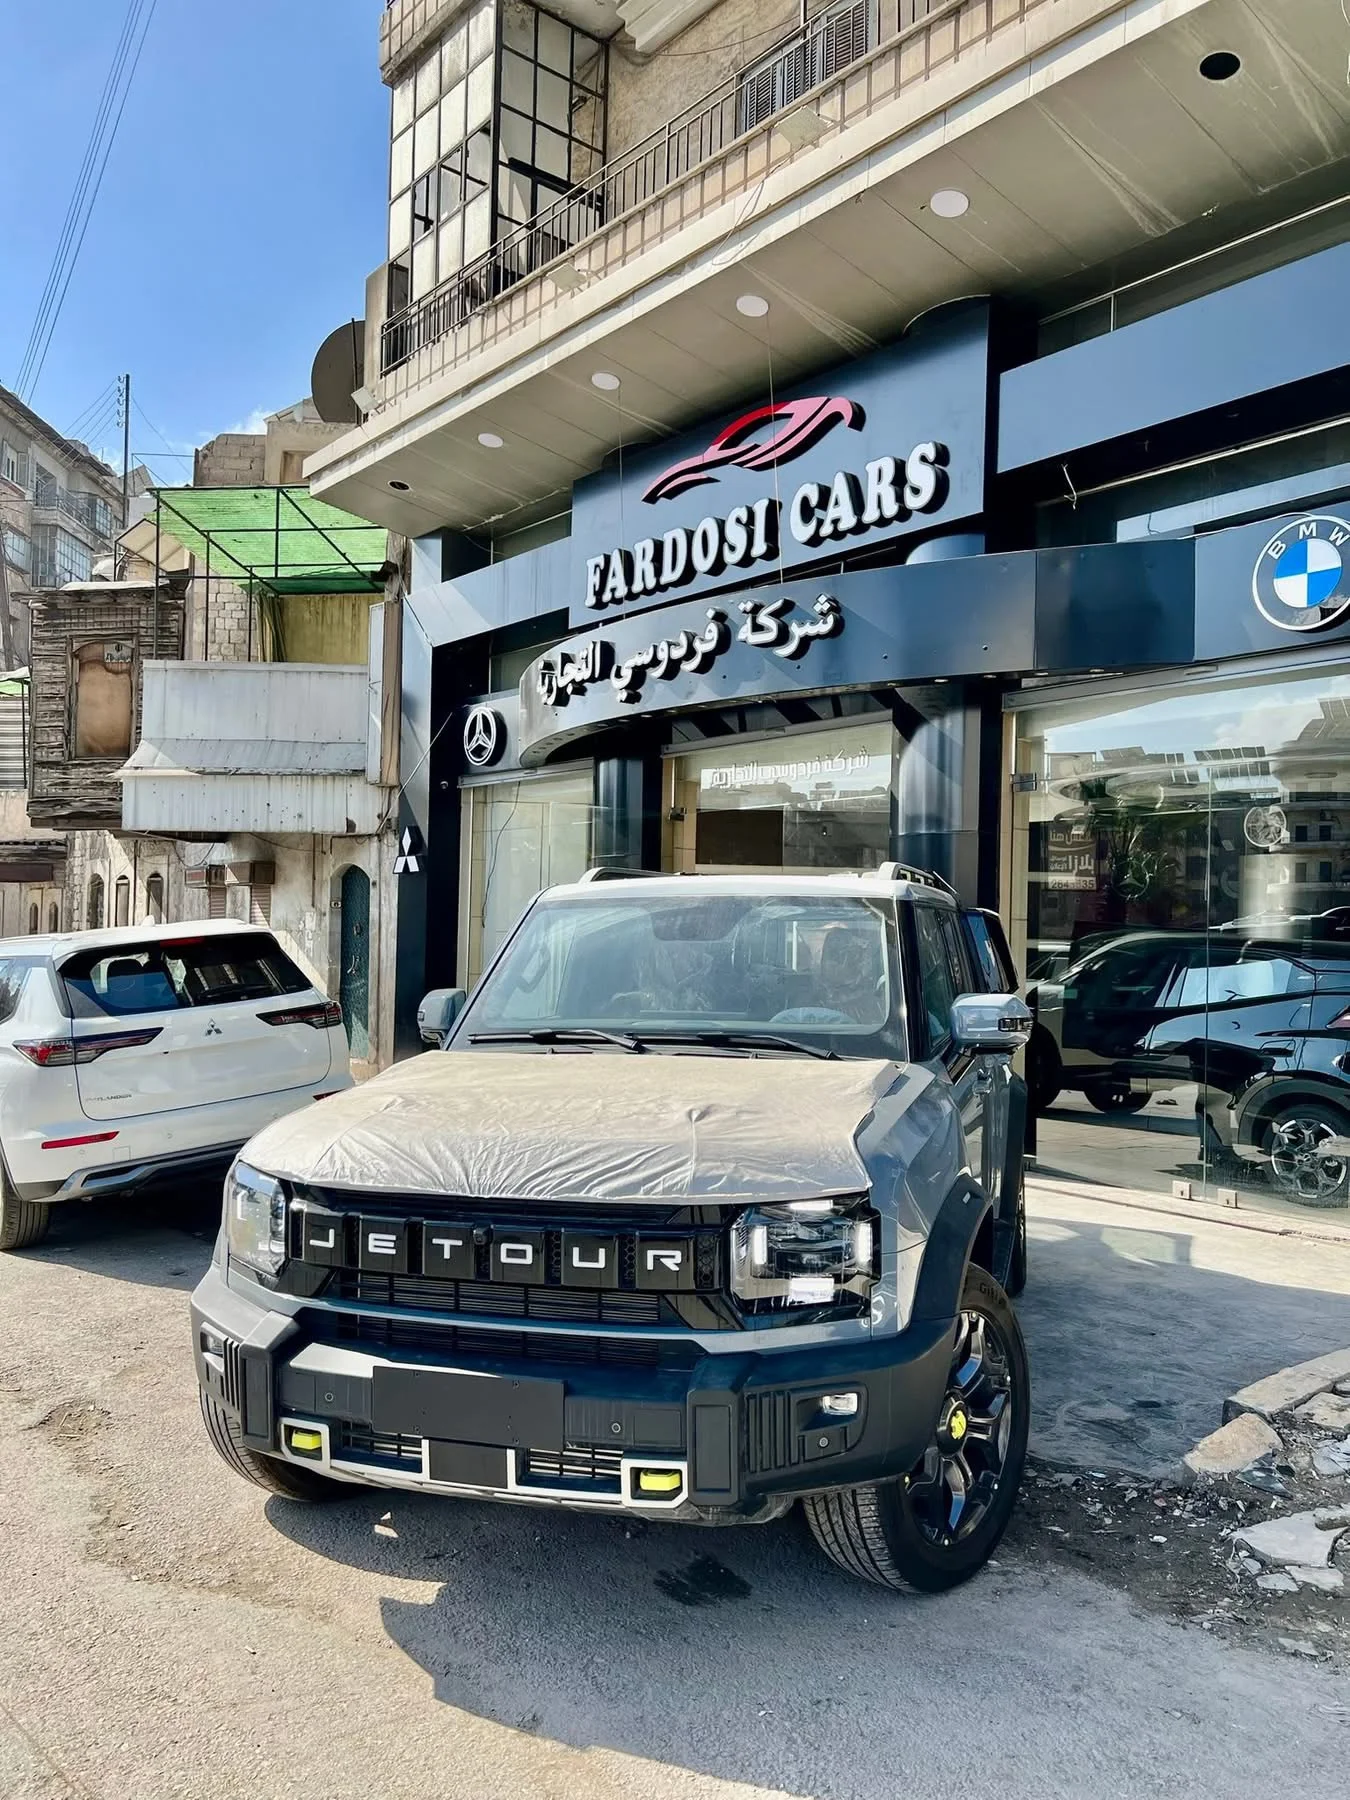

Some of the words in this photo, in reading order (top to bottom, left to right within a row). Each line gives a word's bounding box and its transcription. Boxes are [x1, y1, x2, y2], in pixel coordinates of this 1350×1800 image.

[585, 498, 774, 609] FARDOSI
[790, 441, 943, 544] CARS
[1267, 521, 1350, 561] BMW
[737, 594, 839, 658] شركة
[536, 640, 603, 707] التجارية
[610, 608, 721, 702] فردوسي
[711, 760, 758, 789] التجارية
[760, 755, 822, 785] فردوسي
[823, 746, 870, 776] شركة
[309, 1226, 683, 1272] JETOUR
